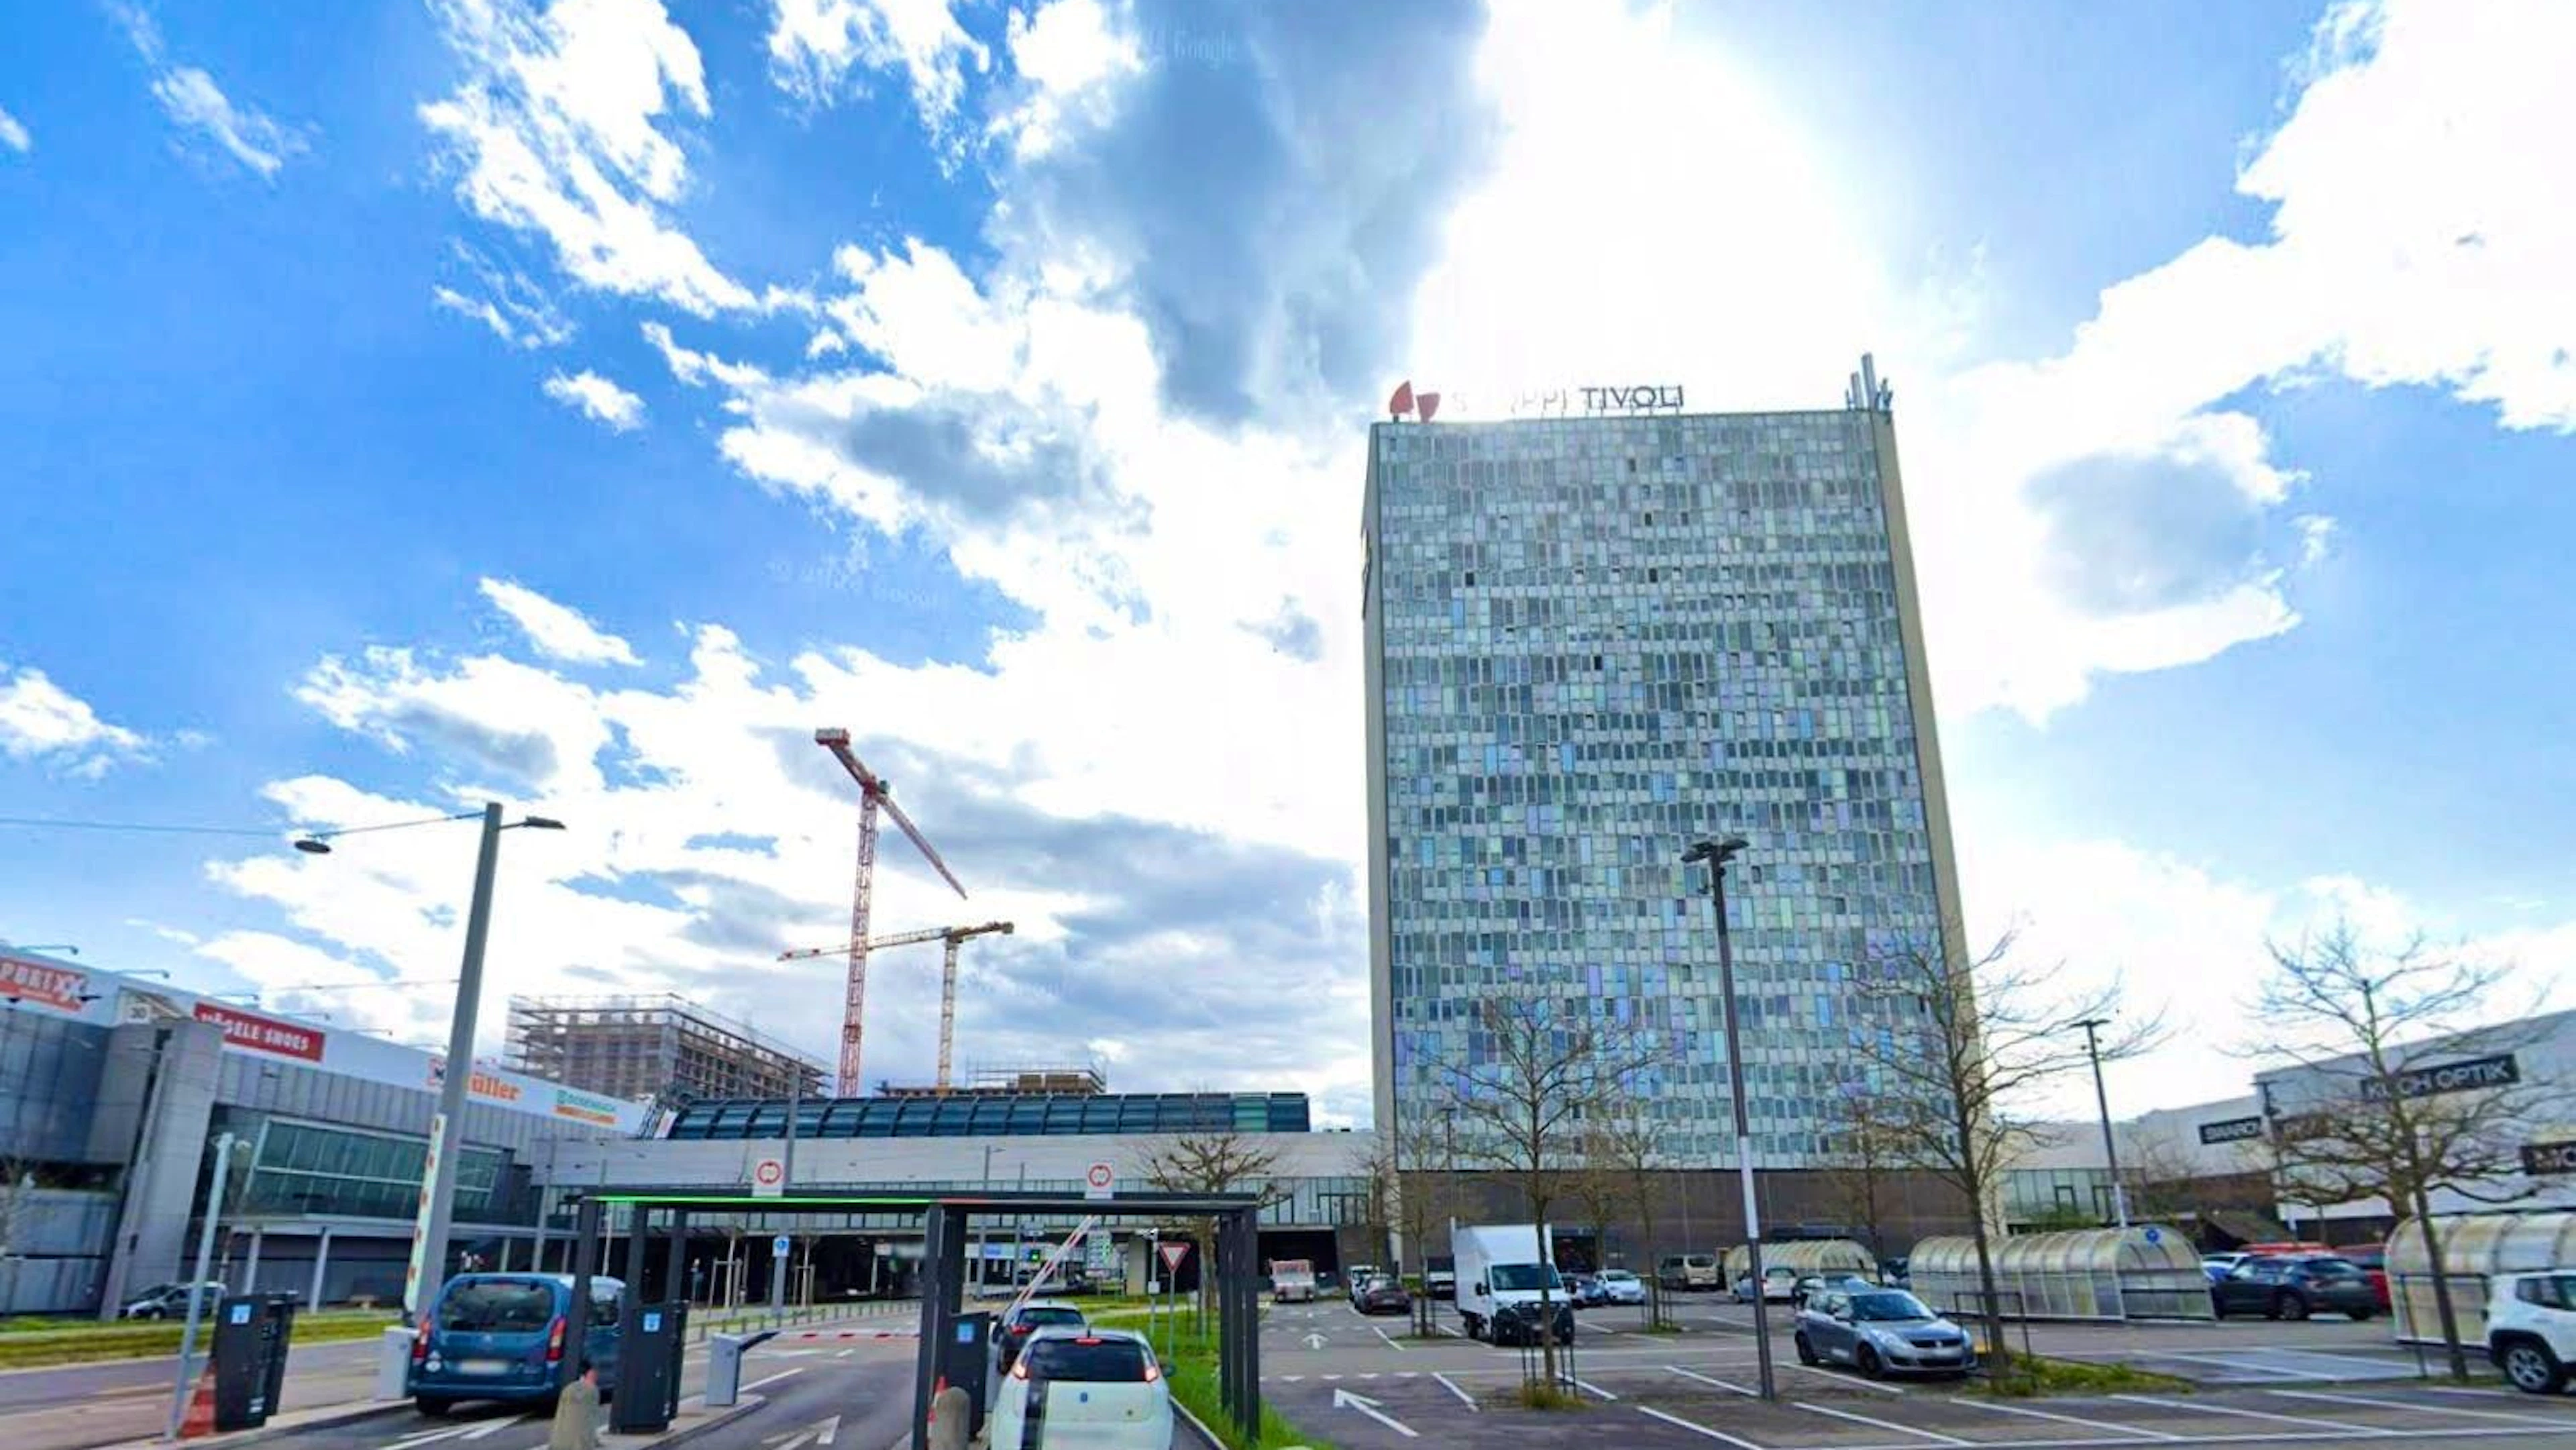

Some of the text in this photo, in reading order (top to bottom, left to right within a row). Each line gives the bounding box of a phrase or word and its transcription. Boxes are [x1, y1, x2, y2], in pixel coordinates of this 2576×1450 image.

[1578, 384, 1684, 408] TIVOLI
[264, 1027, 310, 1051] SHOES
[2435, 1059, 2510, 1088] OPTIK
